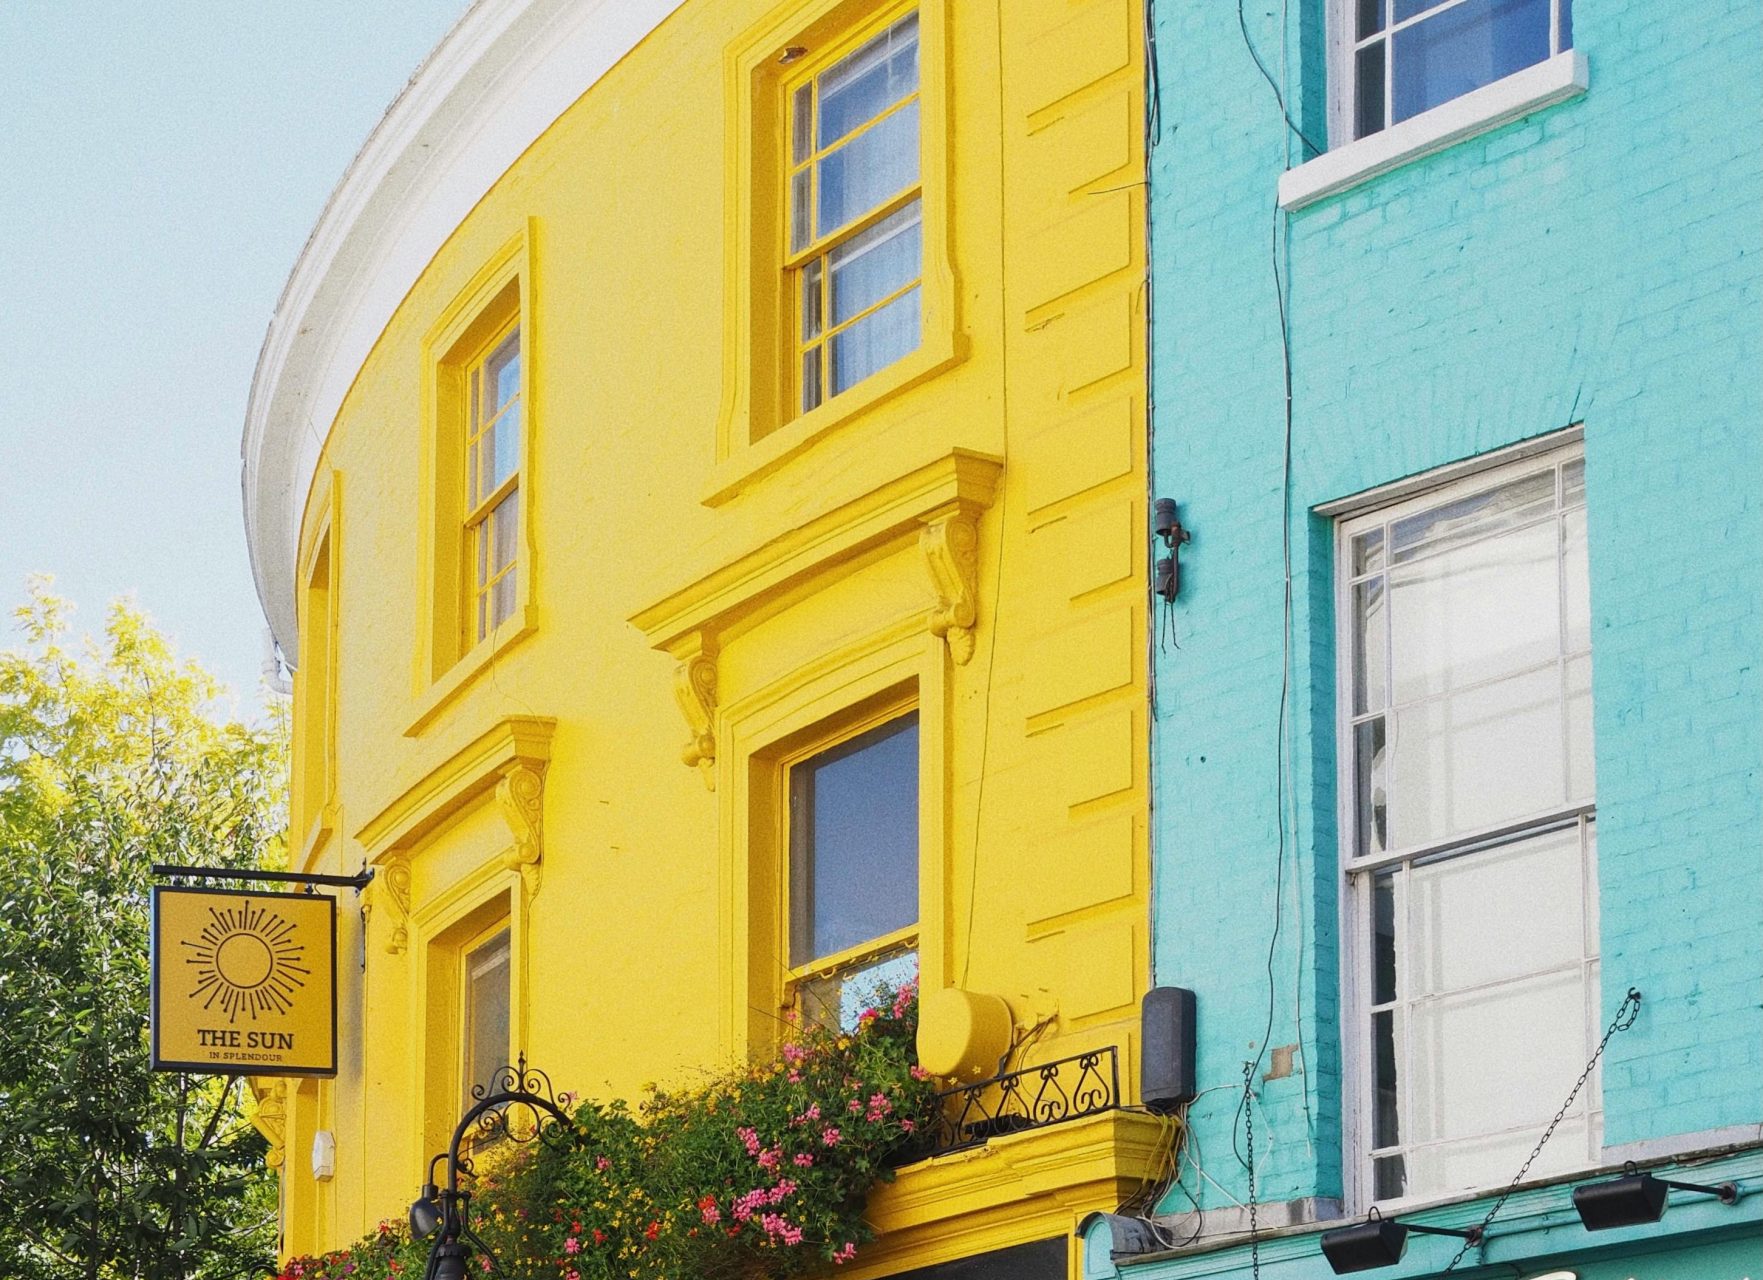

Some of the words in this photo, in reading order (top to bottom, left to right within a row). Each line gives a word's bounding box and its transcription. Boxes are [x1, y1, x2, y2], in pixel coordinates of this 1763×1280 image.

[197, 1029, 241, 1048] THE
[247, 1031, 294, 1050] SUN
[209, 1051, 220, 1060] IN
[223, 1052, 283, 1062] SPLENDOUR
